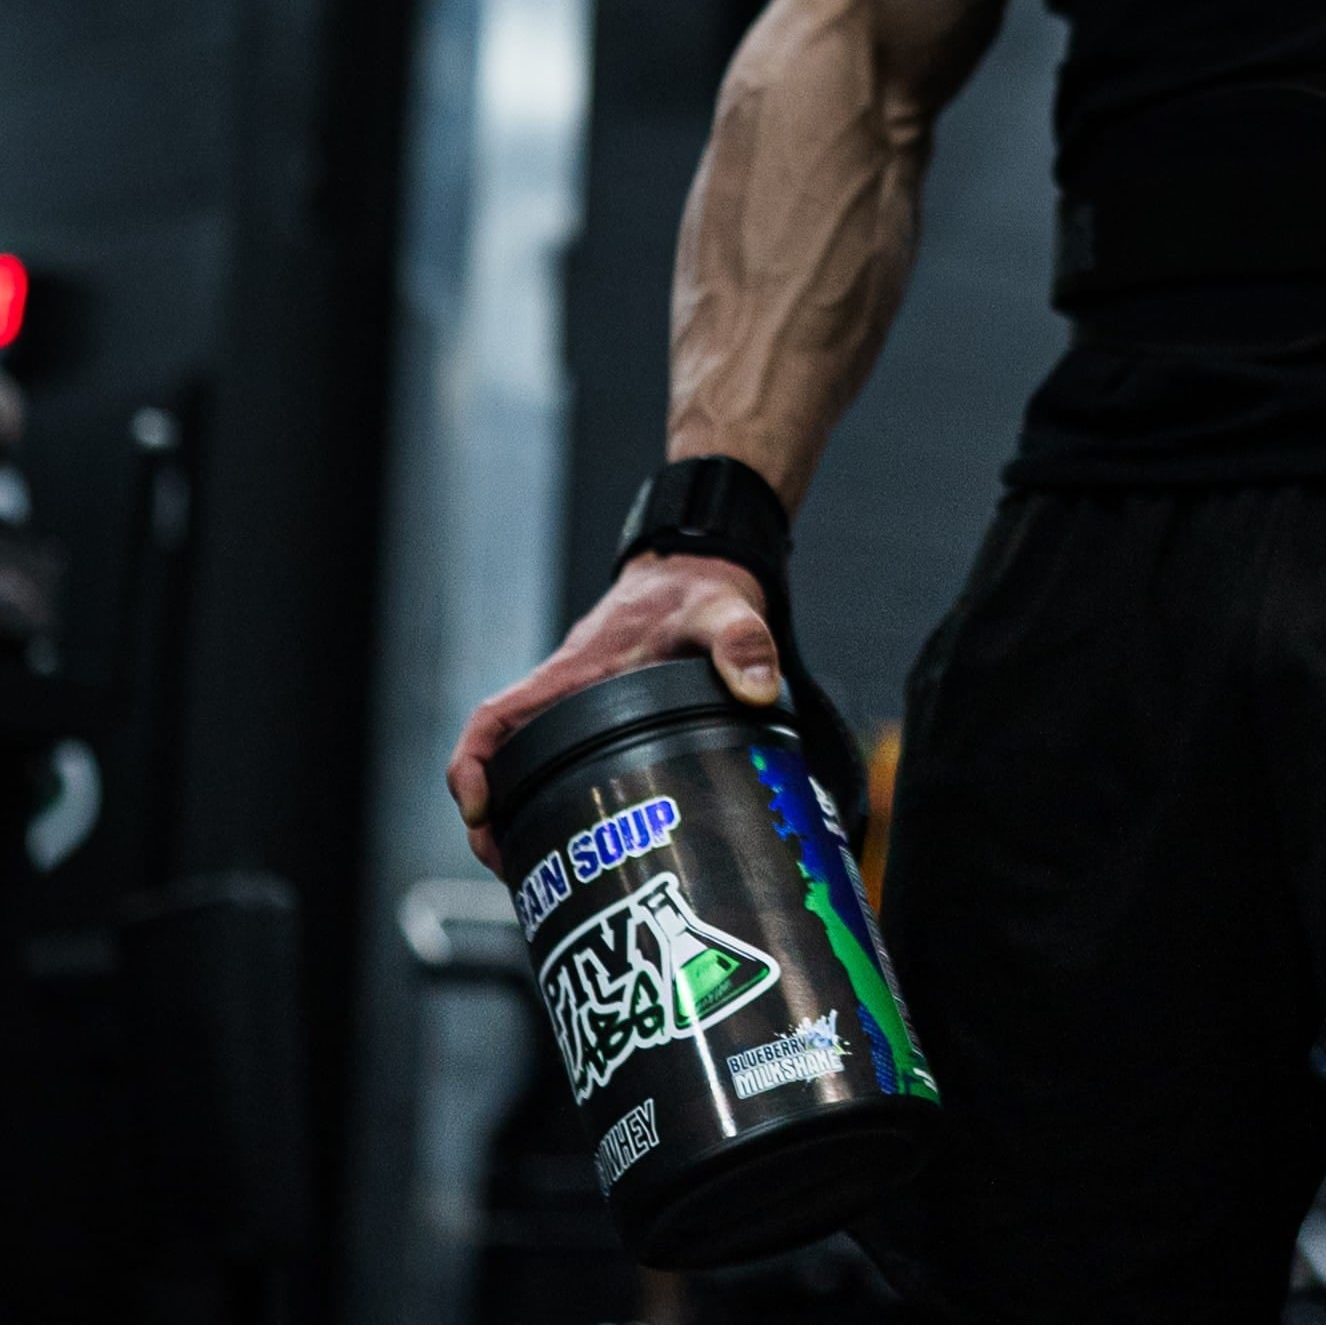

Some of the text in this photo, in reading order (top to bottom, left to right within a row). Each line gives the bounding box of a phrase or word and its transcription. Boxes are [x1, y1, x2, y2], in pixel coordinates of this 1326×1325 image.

[567, 794, 682, 884] SOUP
[728, 1036, 809, 1076] BLUEBERRY
[732, 1048, 846, 1099] MILKSHAKE
[600, 1098, 660, 1185] WHEY
